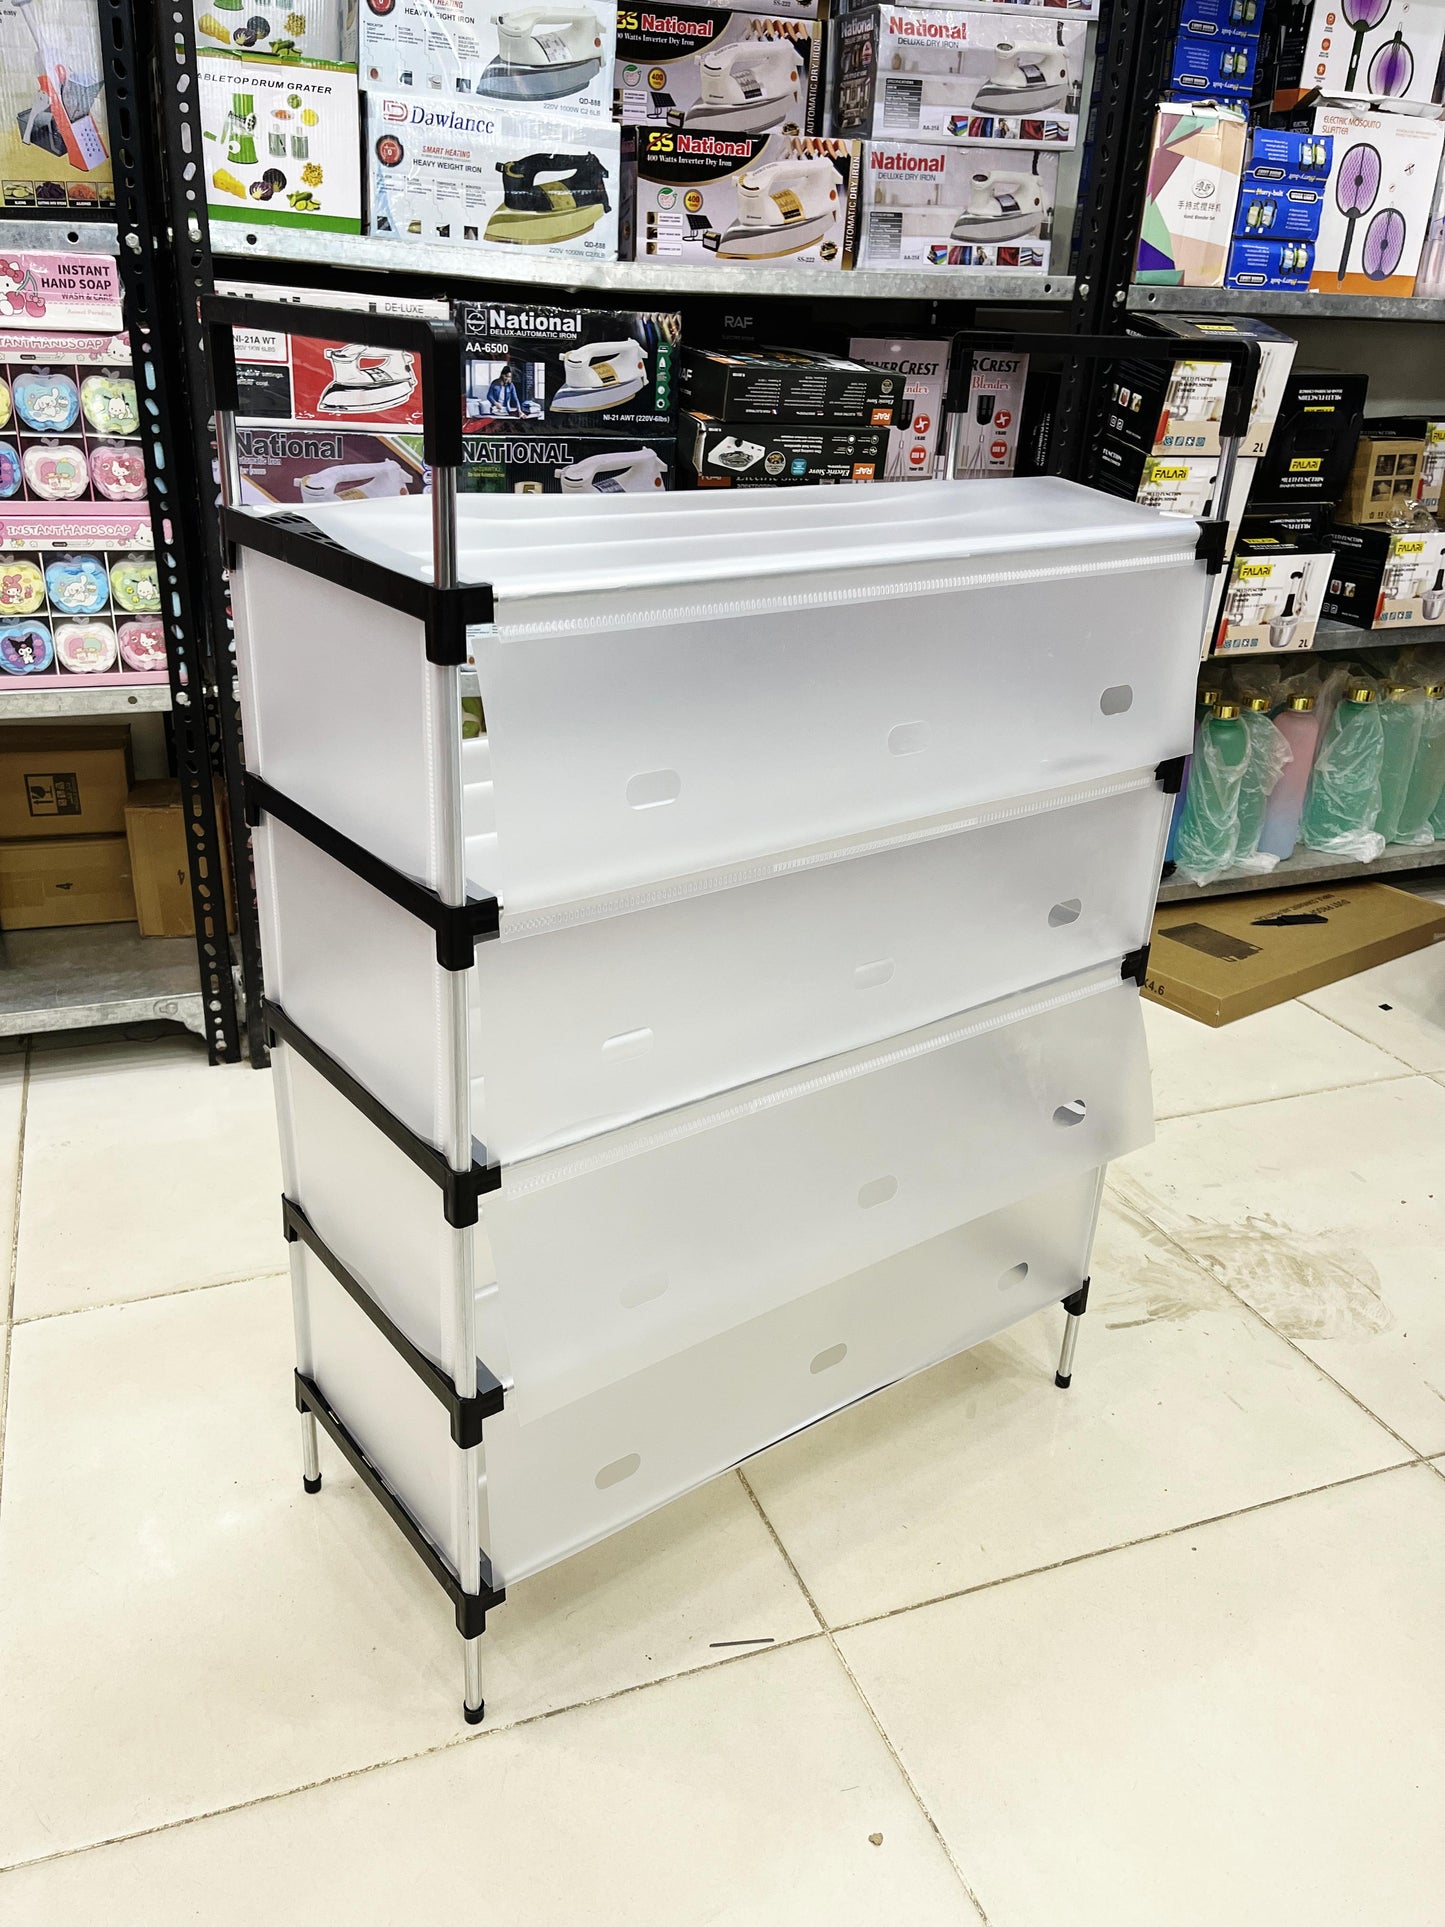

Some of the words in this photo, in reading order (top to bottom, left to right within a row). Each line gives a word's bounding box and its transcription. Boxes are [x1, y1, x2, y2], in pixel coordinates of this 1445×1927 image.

[641, 14, 713, 38] National
[890, 16, 967, 40] National
[812, 40, 821, 61] IRON
[810, 64, 819, 82] DRY
[196, 72, 249, 85] ABLETOP
[252, 78, 284, 88] DRUM
[287, 82, 332, 94] GRATER
[807, 84, 818, 134] AUTOMATIC
[410, 106, 494, 134] Dawlance
[677, 134, 751, 157] National
[413, 159, 435, 167] HEAVY
[437, 162, 463, 171] WEIGHT
[465, 165, 482, 173] IRON
[659, 155, 677, 163] Watts
[678, 156, 704, 165] Inverter
[706, 158, 717, 167] Dry
[718, 158, 732, 167] Iron
[851, 156, 860, 178] IRON
[871, 151, 945, 172] National
[849, 182, 858, 199] DRY
[845, 202, 856, 252] AUTOMATIC
[58, 264, 110, 276] INSTANT
[41, 278, 76, 289] HAND
[79, 279, 111, 290] SOAP
[385, 302, 424, 313] DE-LUXE
[489, 309, 582, 332] National
[724, 316, 753, 328] RAF
[233, 335, 260, 344] NI-21A
[490, 328, 558, 338] DELUX-AUTOMATIC
[465, 342, 509, 354] AA-6500
[972, 357, 1020, 373] RCREST
[906, 382, 929, 394] nder
[972, 374, 1010, 391] Blender
[872, 412, 890, 420] RAF
[236, 430, 343, 460] National
[462, 441, 574, 464] NATIONAL
[1252, 443, 1264, 452] 2L
[808, 468, 825, 476] Stove
[522, 484, 536, 493] 5
[1298, 640, 1308, 648] 2L
